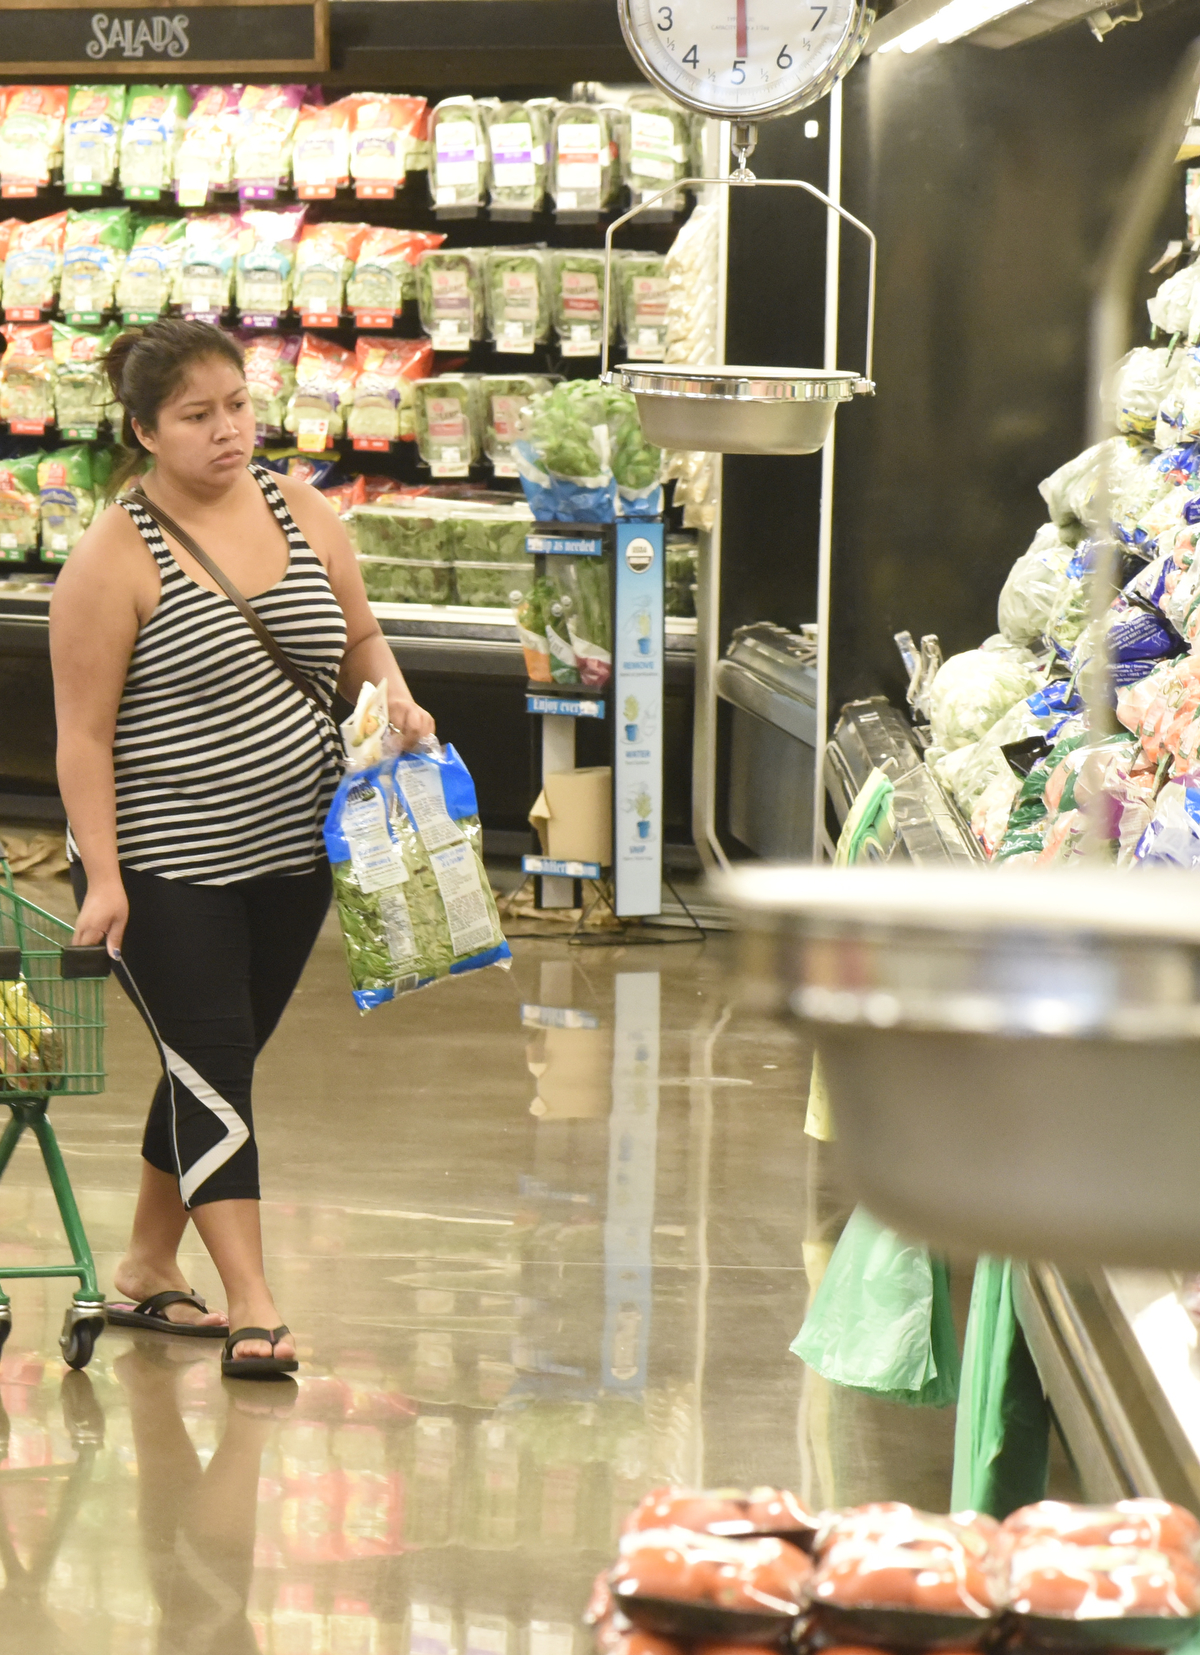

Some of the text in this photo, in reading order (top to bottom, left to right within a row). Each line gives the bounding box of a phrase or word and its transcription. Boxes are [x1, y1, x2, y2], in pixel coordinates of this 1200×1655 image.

[657, 6, 673, 31] 3
[810, 6, 828, 31] 7
[86, 13, 189, 59] SALADS
[682, 45, 699, 69] 4
[776, 44, 793, 69] 6
[731, 61, 746, 85] 5
[553, 541, 564, 551] as
[565, 539, 596, 553] needed
[623, 661, 654, 670] REMOVE
[533, 697, 558, 713] Enjoy
[625, 750, 651, 758] WATER
